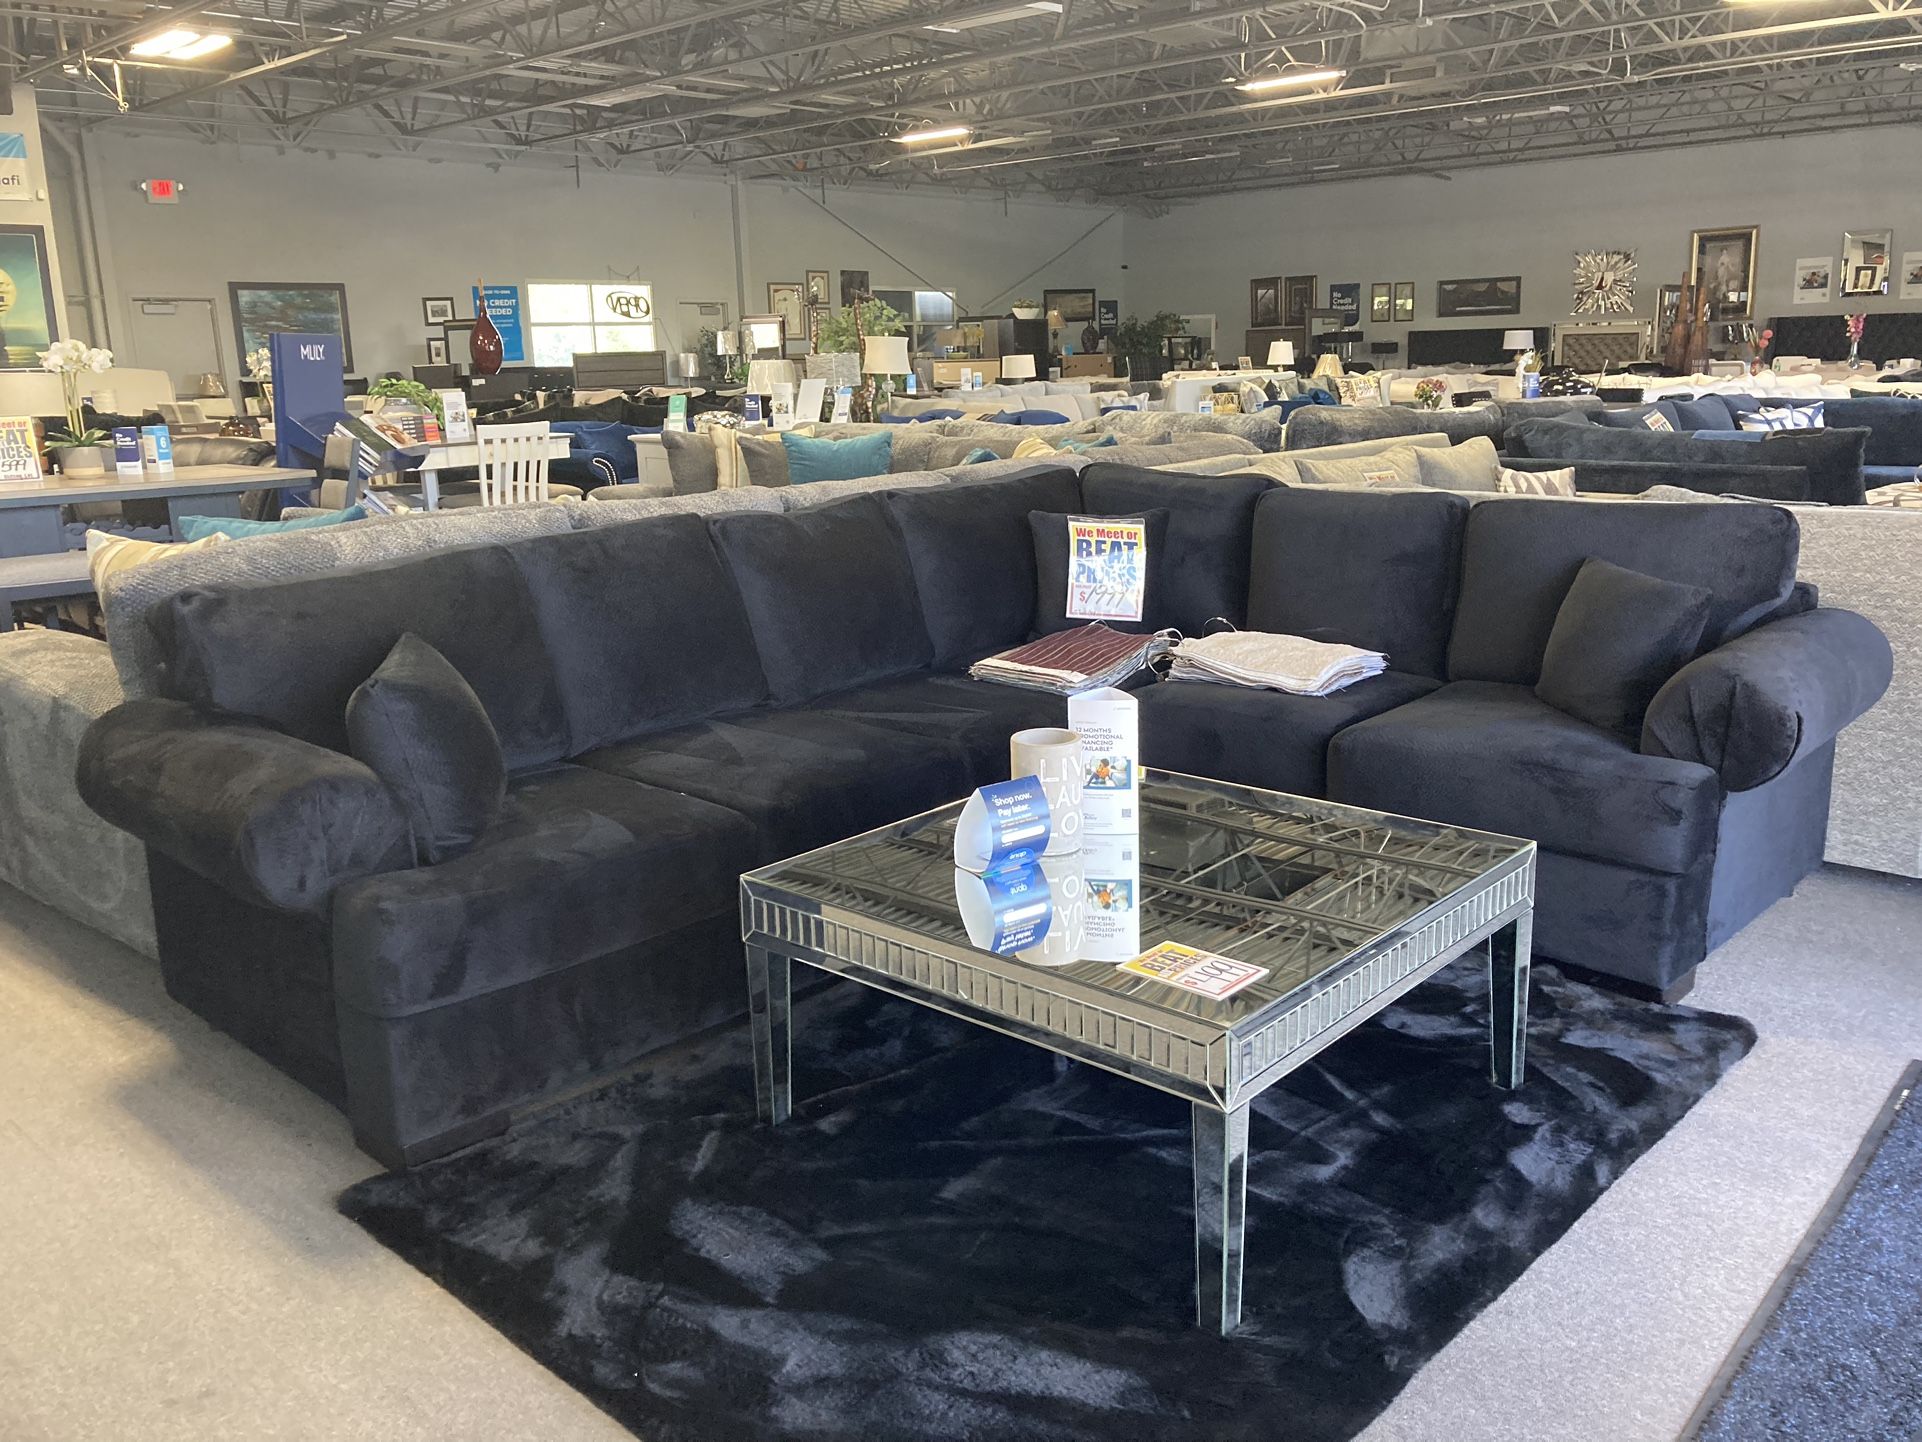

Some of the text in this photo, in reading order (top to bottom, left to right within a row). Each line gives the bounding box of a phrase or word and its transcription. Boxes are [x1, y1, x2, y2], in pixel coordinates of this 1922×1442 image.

[0, 174, 21, 186] afi
[0, 429, 28, 445] AT
[0, 444, 33, 459] ICES
[1076, 528, 1138, 540] We Meet or
[1076, 538, 1138, 565] BEAT
[995, 792, 1033, 807] Shop now.
[997, 808, 1012, 817] Pay
[1140, 949, 1189, 972] BEAT
